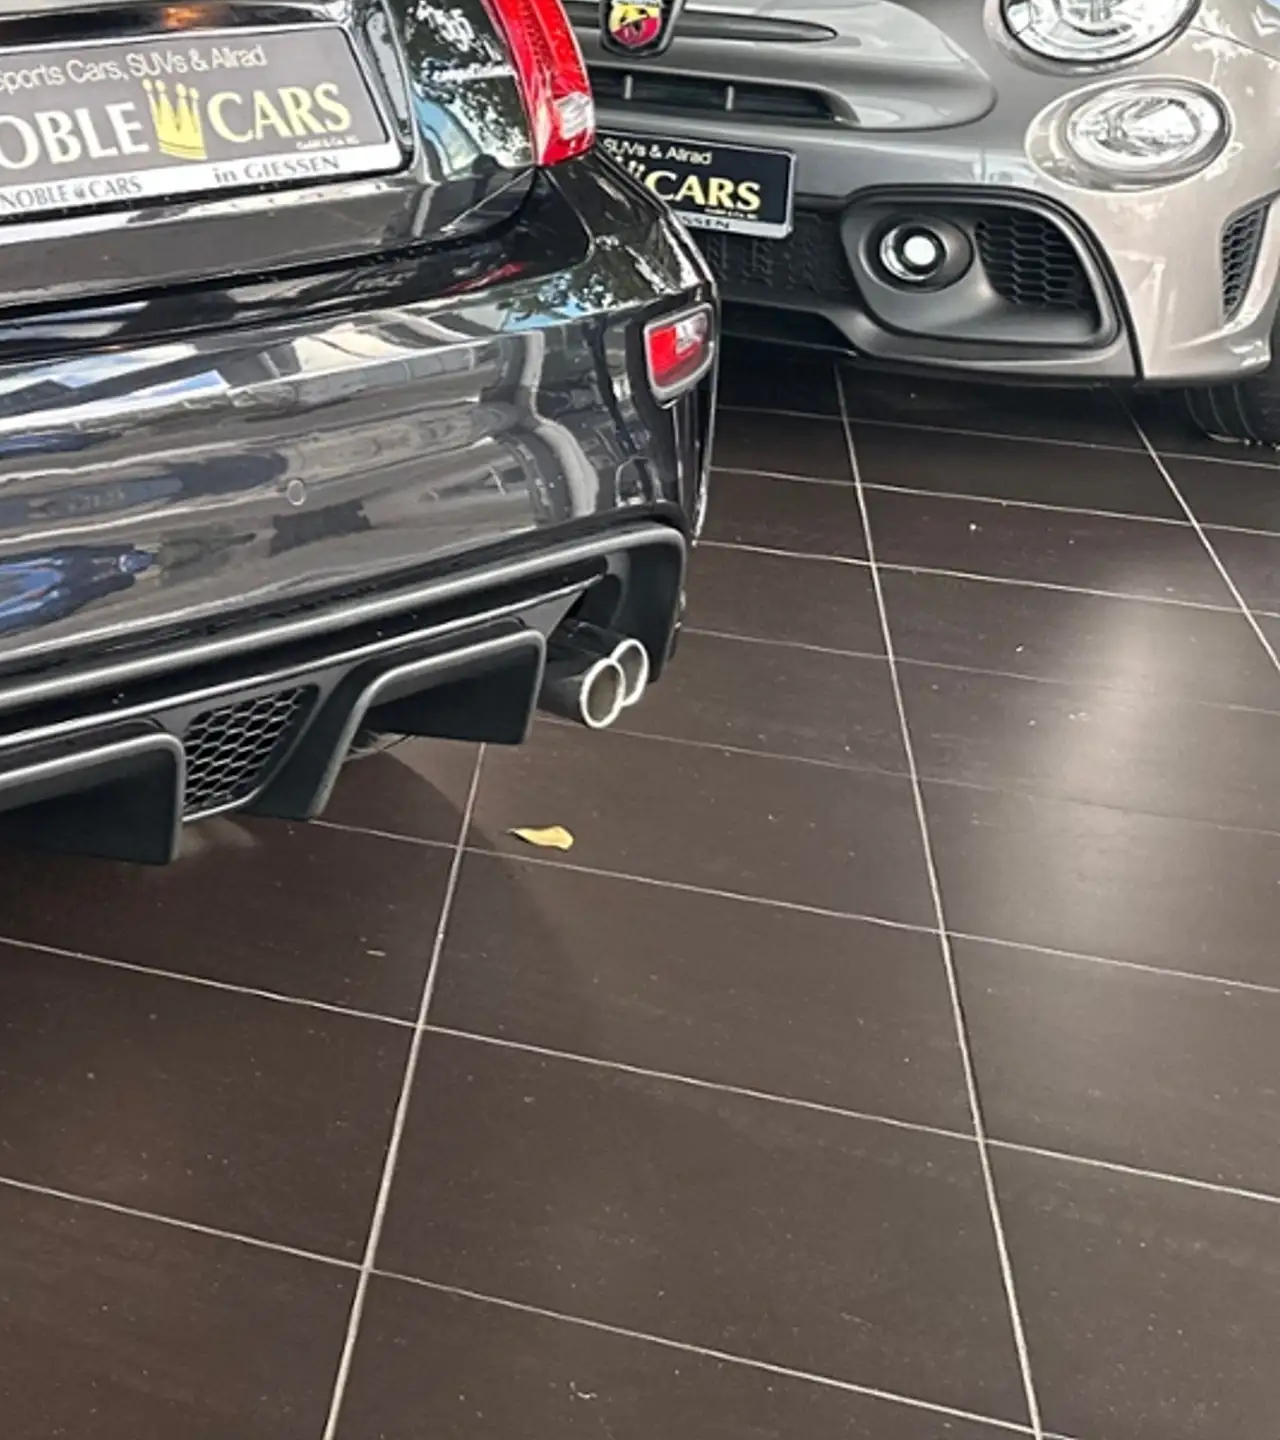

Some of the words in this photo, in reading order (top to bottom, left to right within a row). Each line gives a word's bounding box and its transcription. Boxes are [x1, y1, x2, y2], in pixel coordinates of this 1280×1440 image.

[66, 59, 128, 83] Cars,
[125, 51, 188, 77] SUVs
[189, 49, 209, 71] &
[211, 44, 268, 68] Allrad
[207, 82, 351, 144] CARS
[603, 137, 646, 157] SUVs
[649, 144, 663, 159] &
[666, 146, 713, 166] Allrad
[89, 175, 143, 198] CARS
[214, 166, 238, 183] in
[243, 155, 339, 180] GIESSEN
[644, 170, 761, 212] CARS
